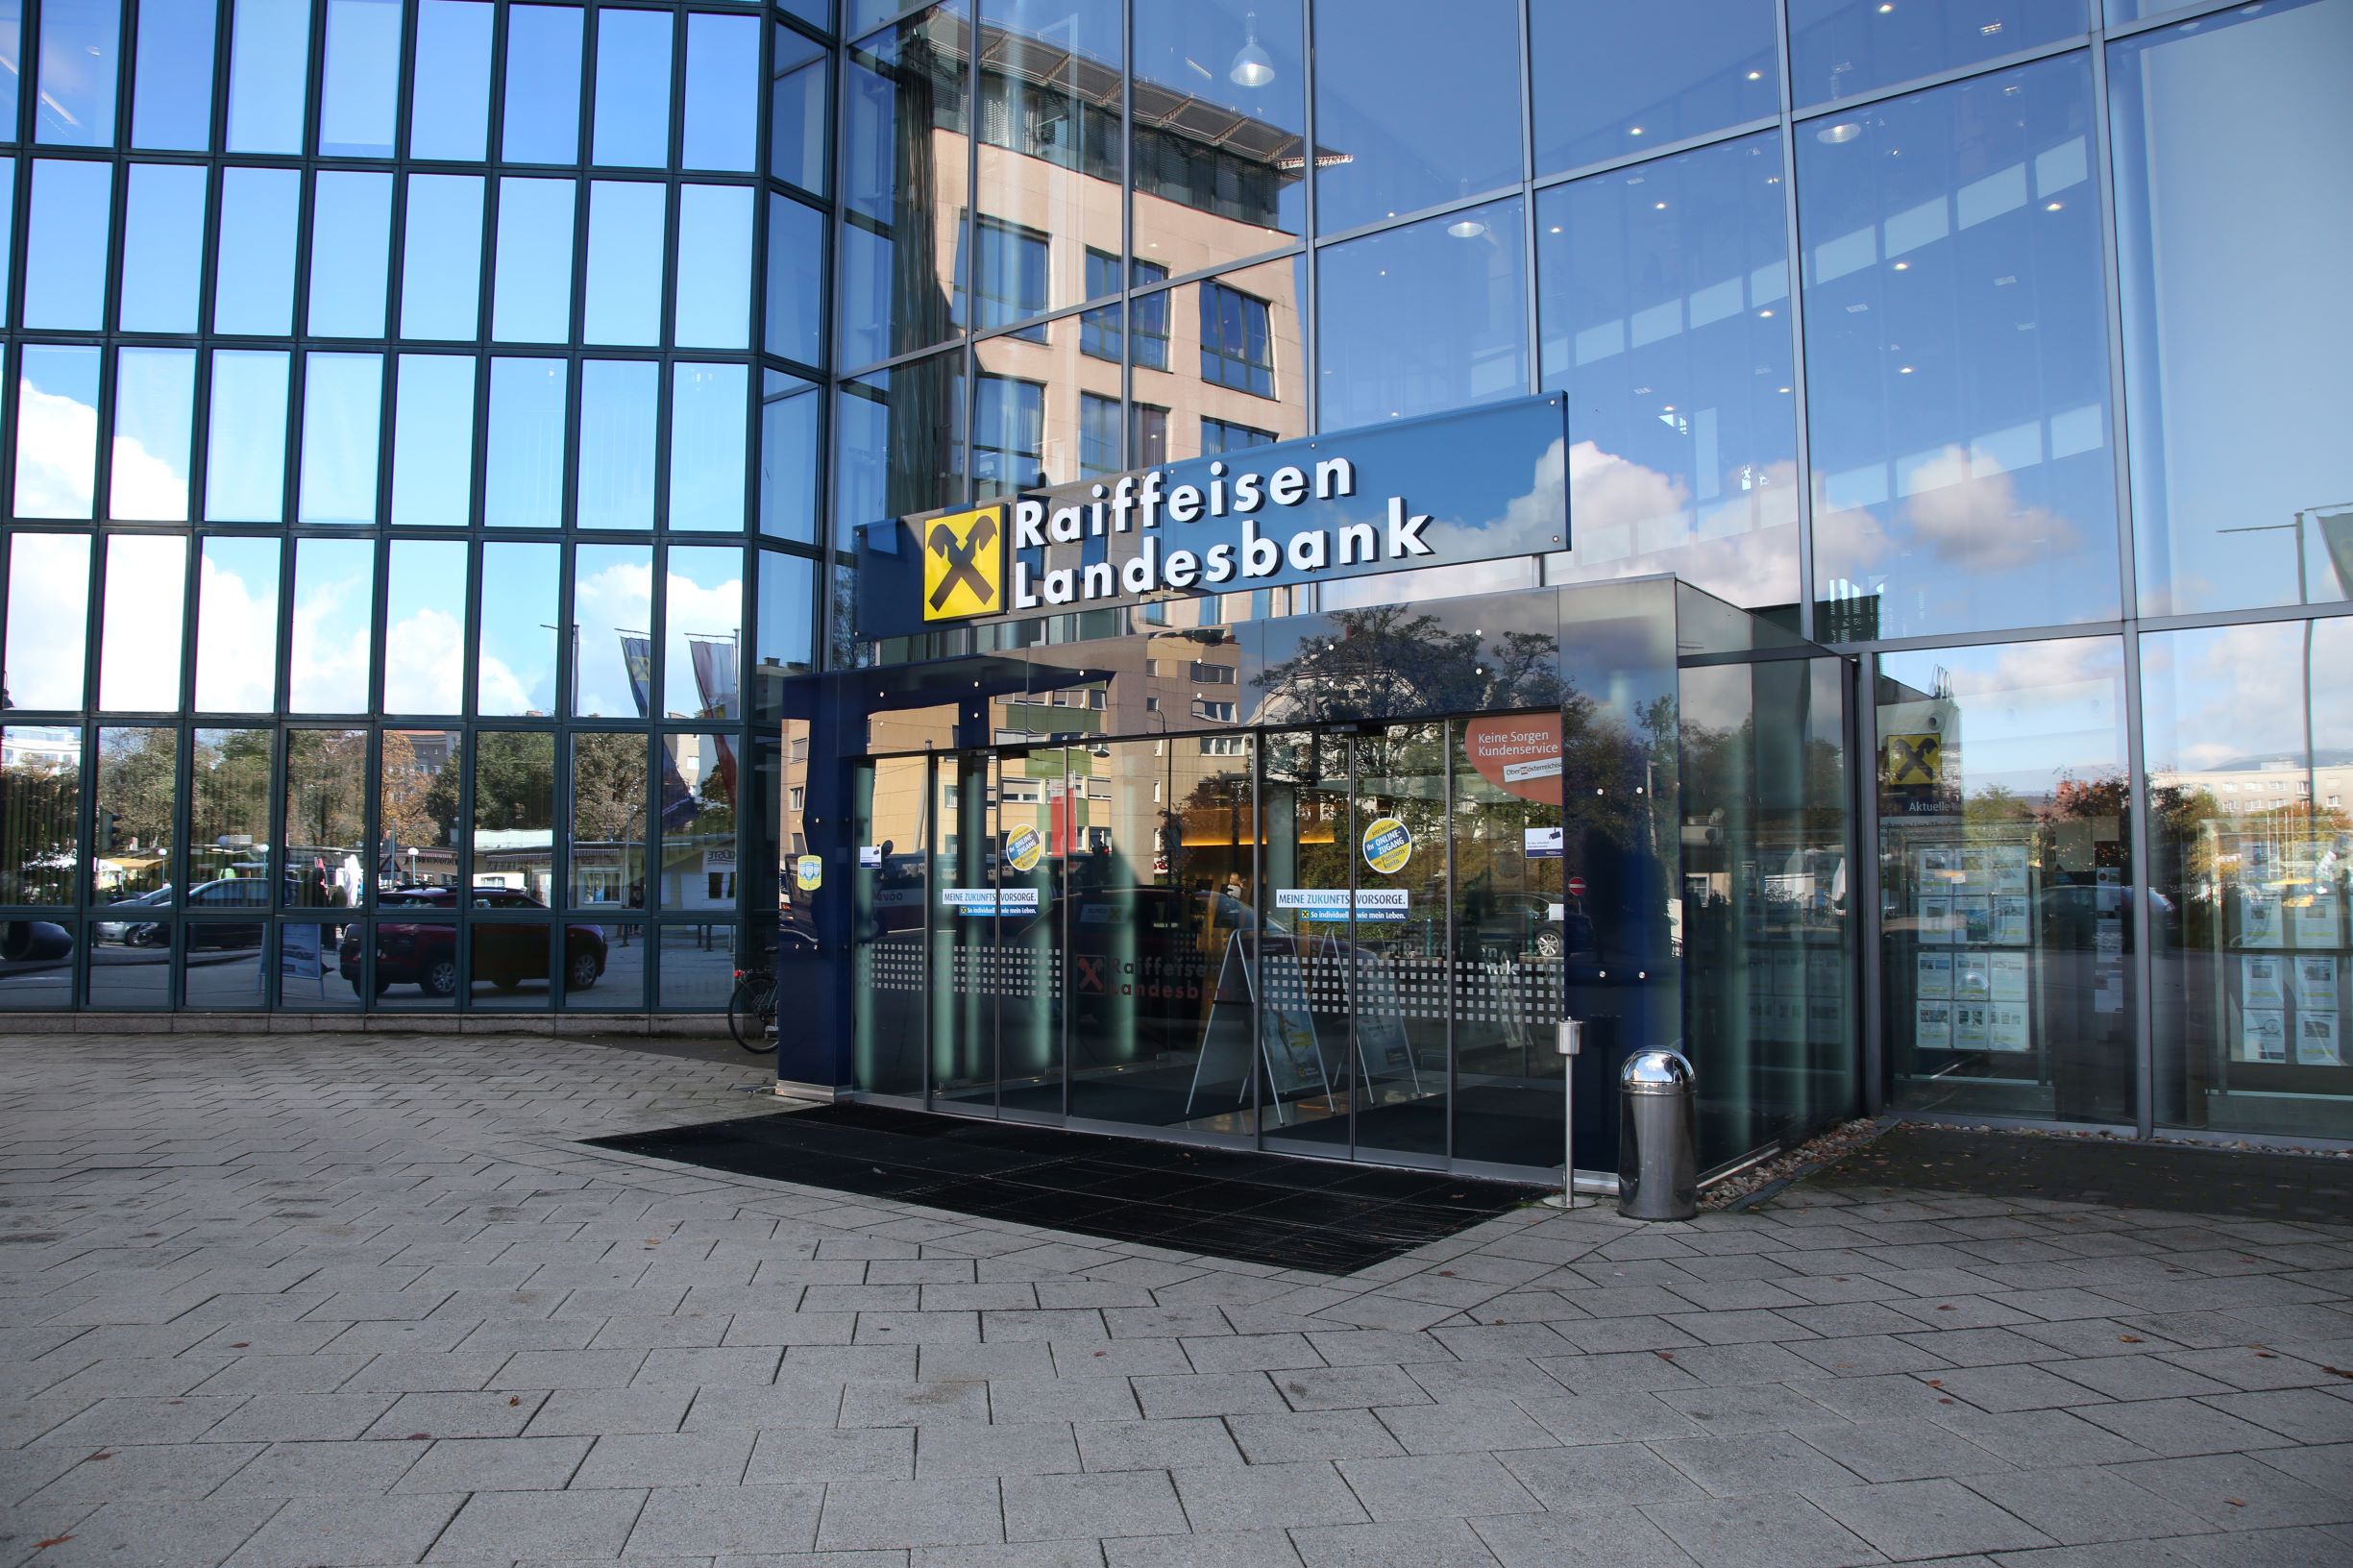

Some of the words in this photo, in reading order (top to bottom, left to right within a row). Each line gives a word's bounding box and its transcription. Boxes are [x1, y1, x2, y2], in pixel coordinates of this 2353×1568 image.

[1016, 456, 1355, 548] Raiffeisen
[1016, 497, 1434, 609] Landesbank
[1478, 732, 1507, 744] Keine
[1510, 731, 1549, 745] Sorgen
[1478, 743, 1558, 756] Kundenservice
[1908, 801, 1949, 812] Aktuelle
[1375, 829, 1401, 846] ONLINE-
[1378, 837, 1405, 854] ZUGANG
[944, 893, 963, 901] MEINE
[1279, 894, 1305, 904] MEINE
